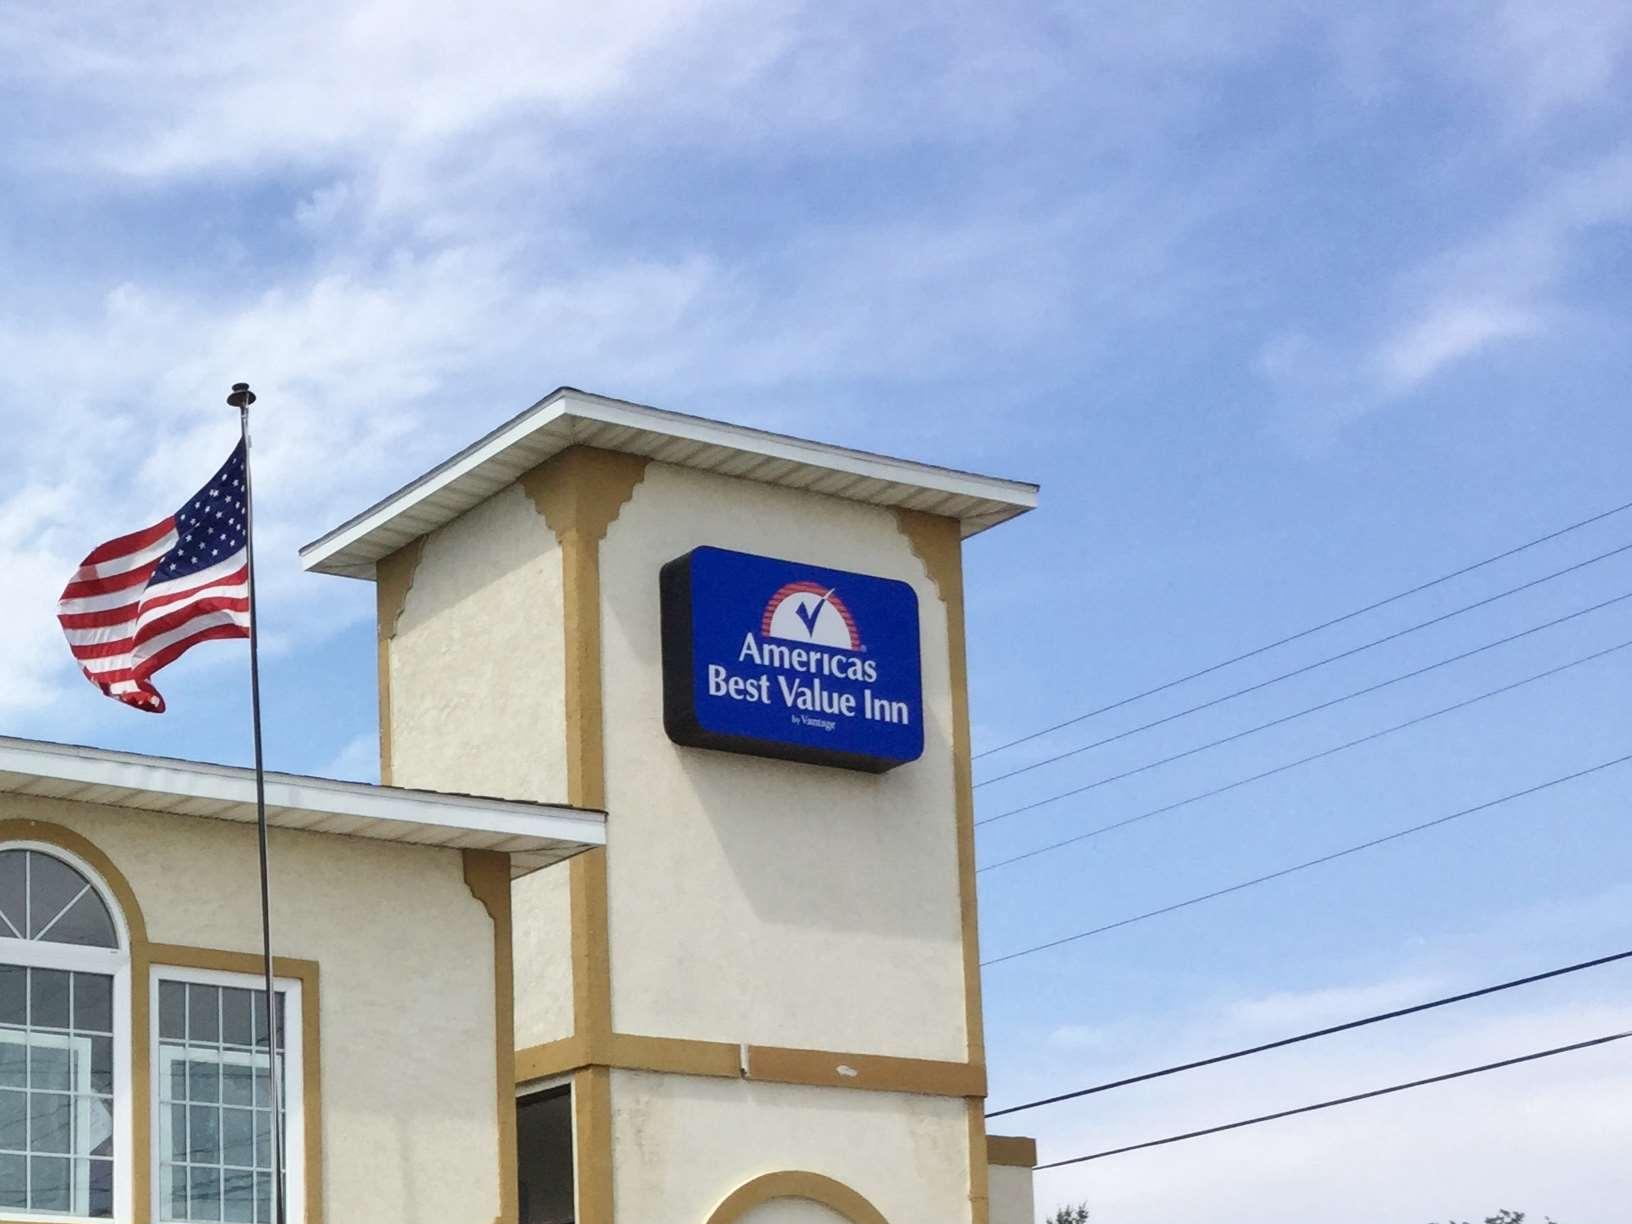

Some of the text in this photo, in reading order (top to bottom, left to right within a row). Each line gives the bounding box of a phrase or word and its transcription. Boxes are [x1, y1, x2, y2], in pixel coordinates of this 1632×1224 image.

[739, 632, 877, 682] Americas
[708, 664, 909, 725] Best Value Inn
